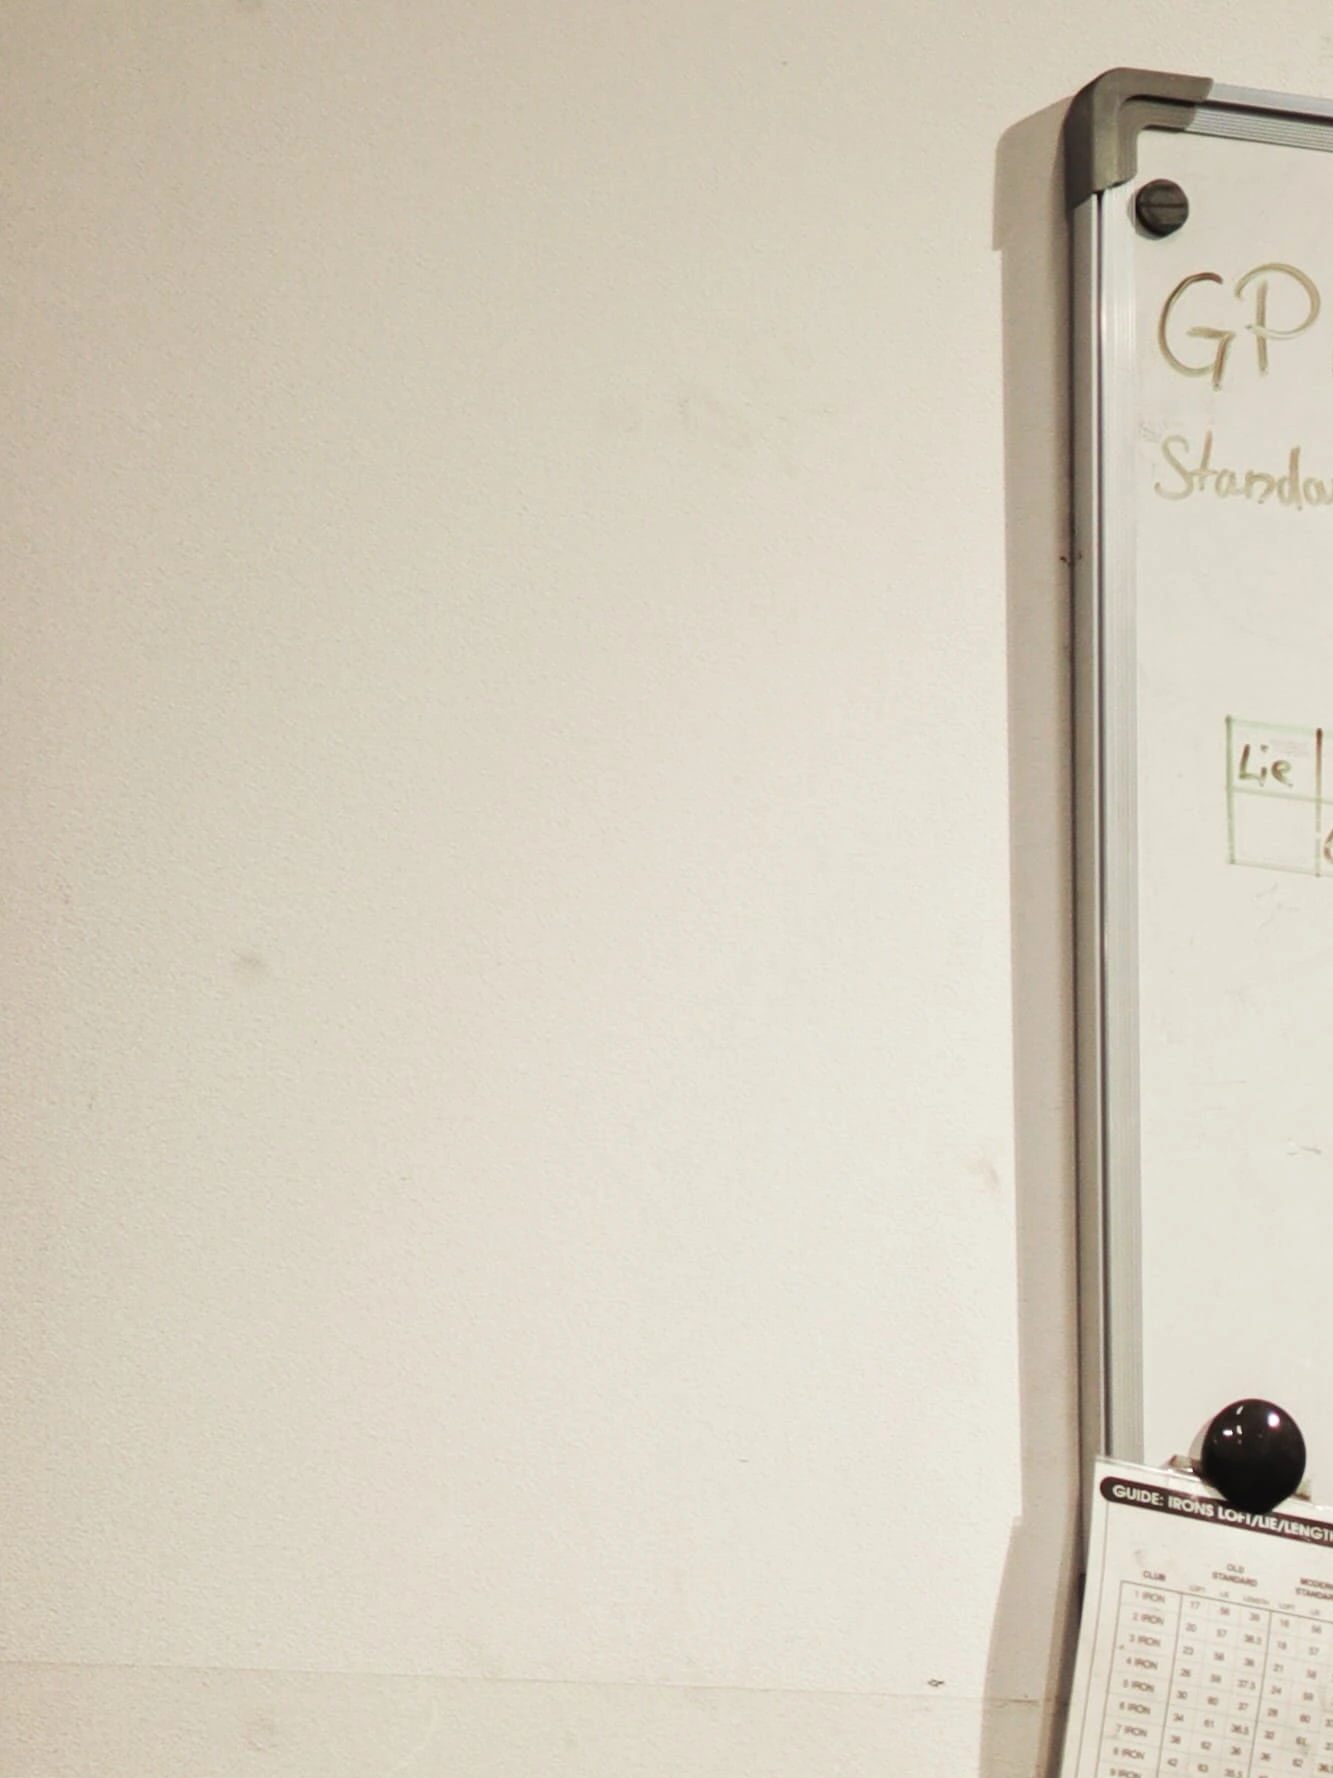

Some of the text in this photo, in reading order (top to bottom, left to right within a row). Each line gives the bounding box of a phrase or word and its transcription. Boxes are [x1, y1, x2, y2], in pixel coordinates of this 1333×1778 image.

[1238, 744, 1293, 789] Lie
[1111, 1483, 1164, 1507] GUIDE:
[1168, 1495, 1215, 1518] IRONS
